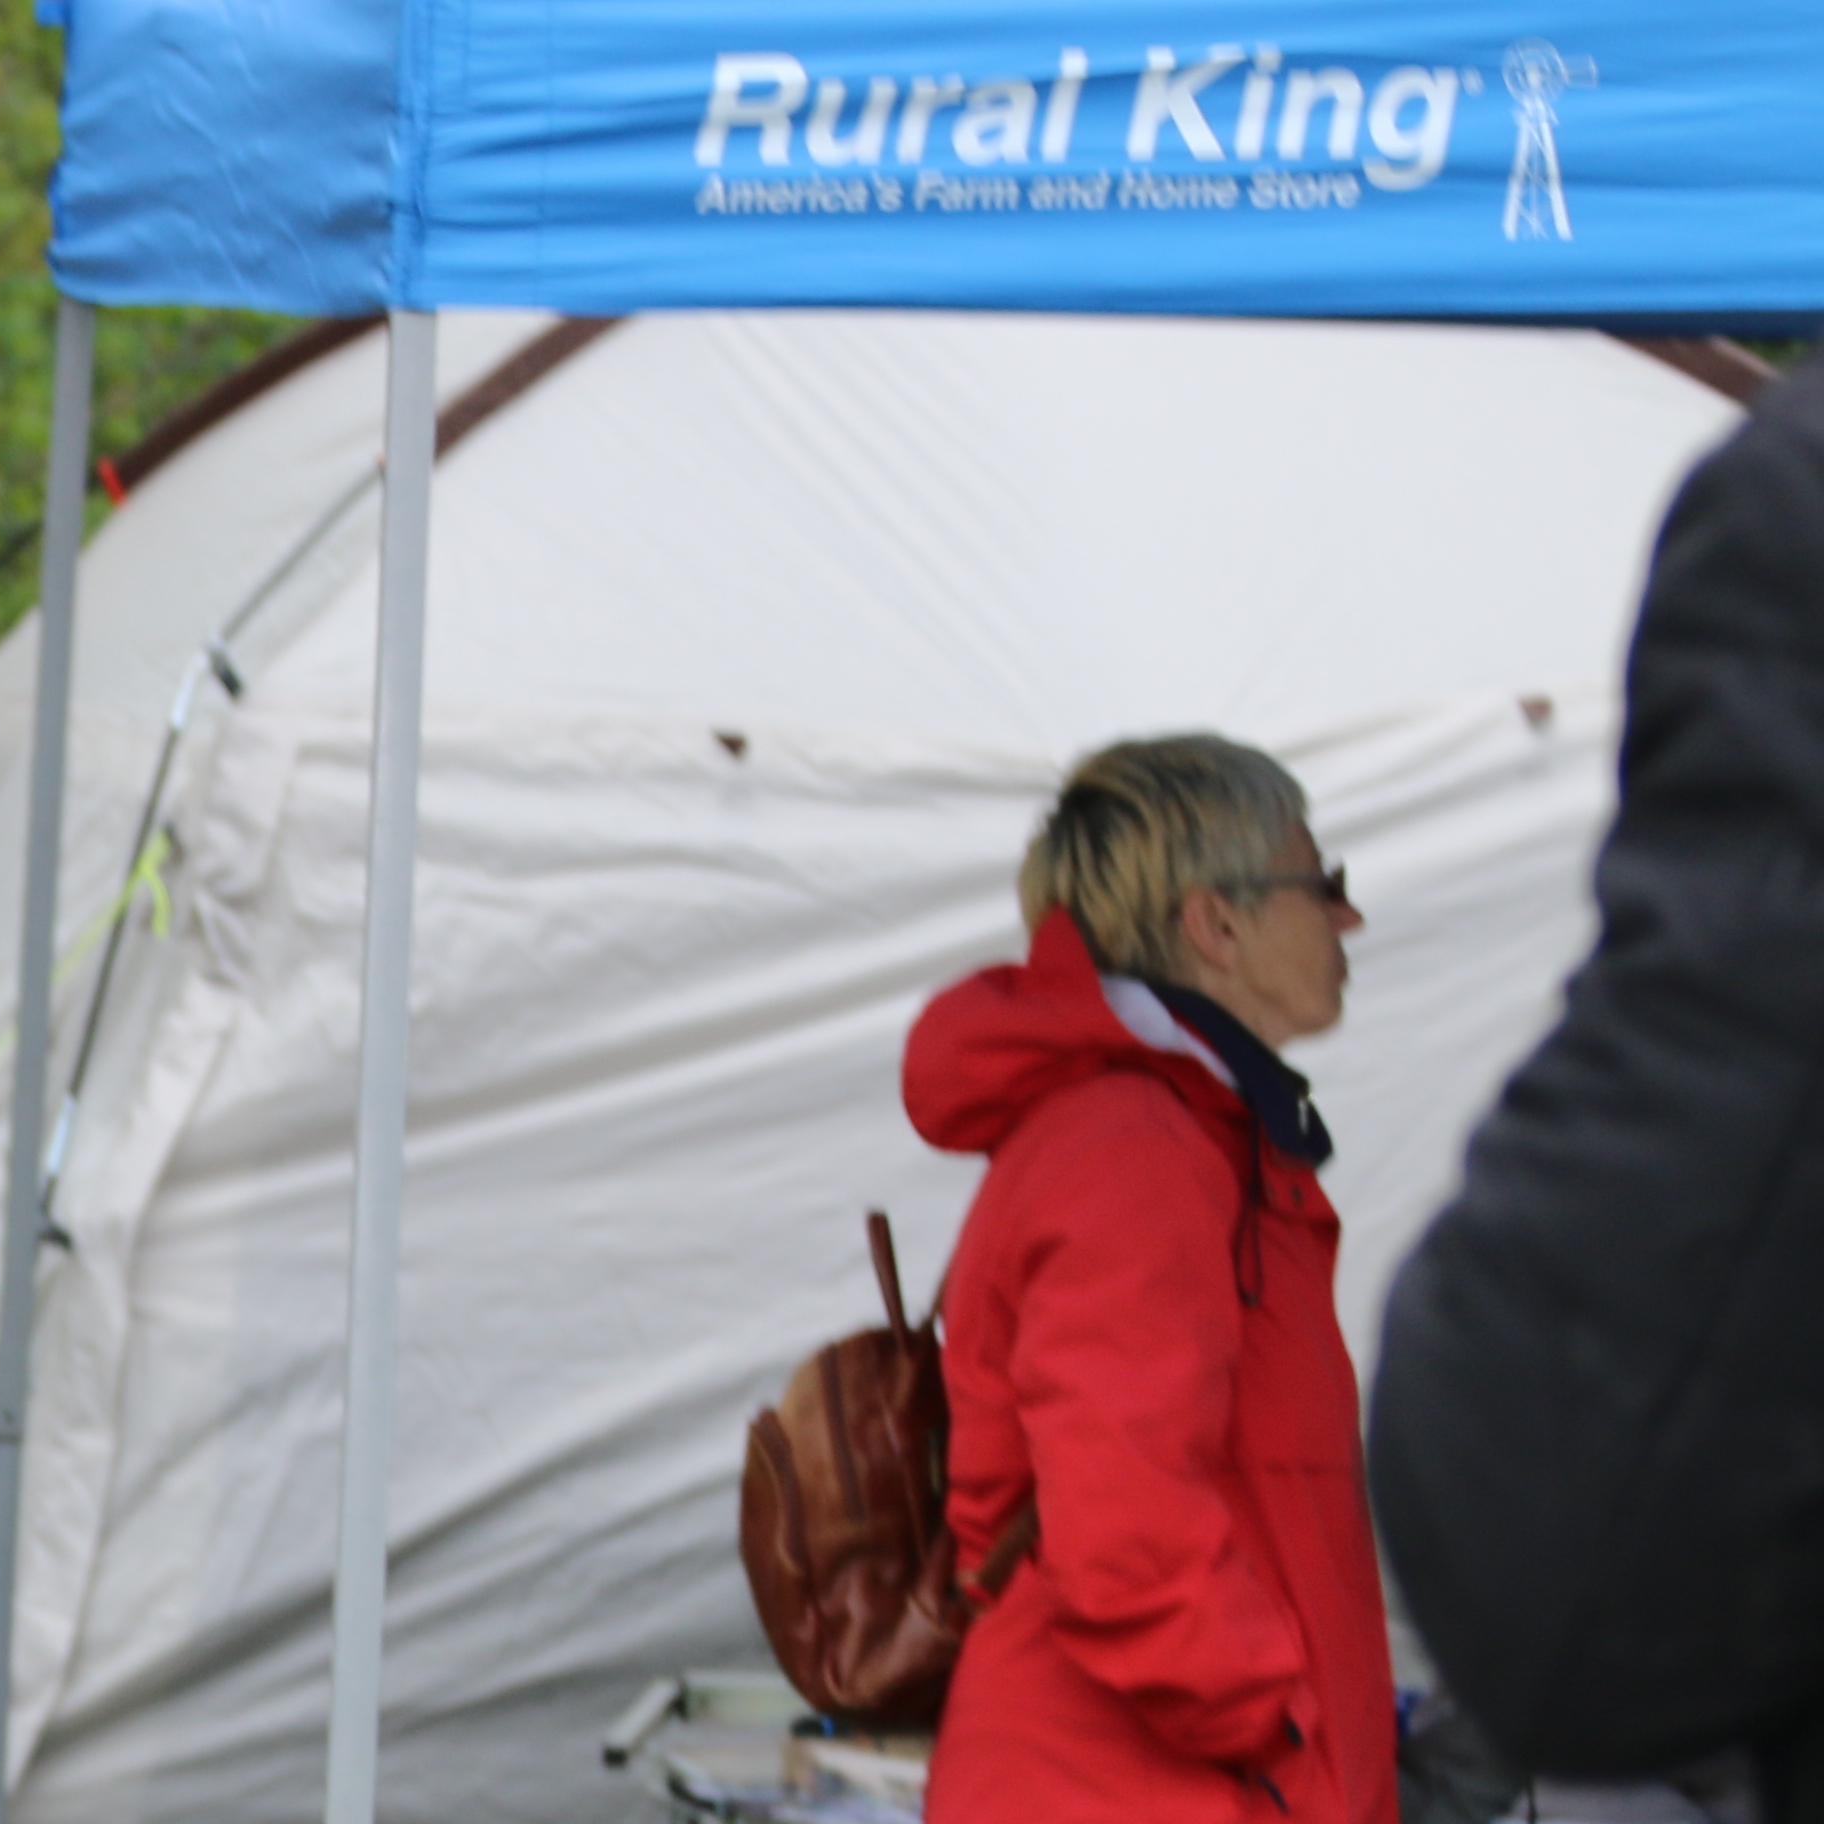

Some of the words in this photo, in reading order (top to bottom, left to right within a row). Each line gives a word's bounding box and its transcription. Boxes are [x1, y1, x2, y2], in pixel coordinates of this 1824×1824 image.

[693, 45, 1088, 168] Rural
[1125, 42, 1460, 191] King
[695, 169, 904, 215] America's
[913, 168, 1021, 212] Farm
[1028, 168, 1111, 212] and
[1117, 167, 1240, 210] Home
[1246, 166, 1361, 210] Store
